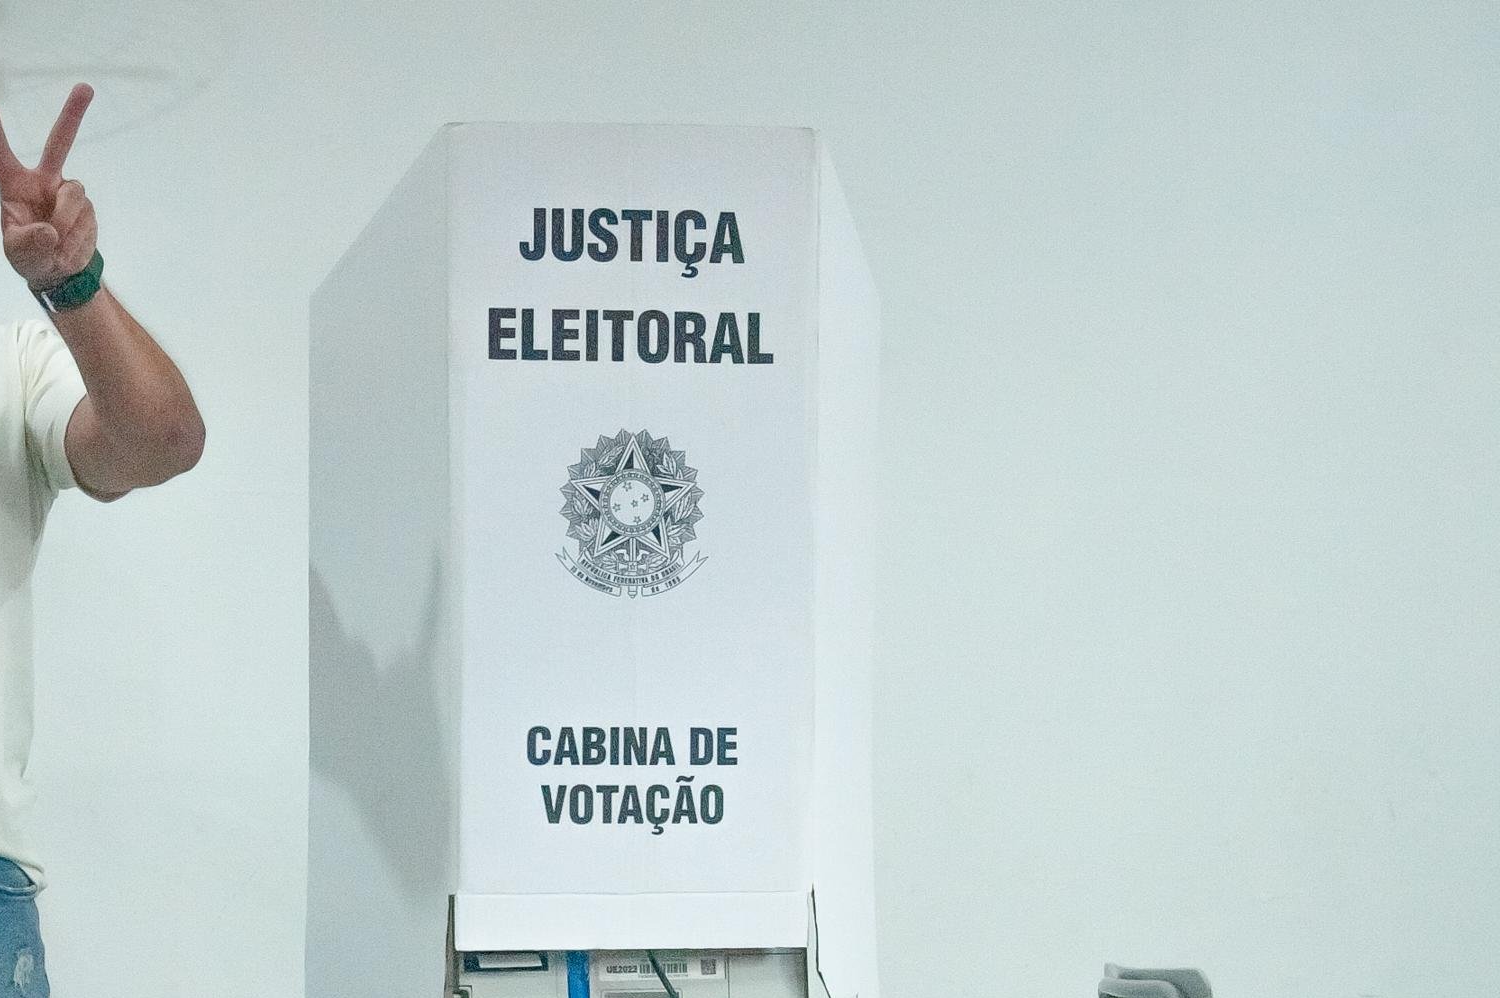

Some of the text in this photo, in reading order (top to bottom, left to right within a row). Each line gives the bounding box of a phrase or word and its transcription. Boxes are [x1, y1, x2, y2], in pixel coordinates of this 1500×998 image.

[518, 207, 746, 278] JUSTIÇA
[487, 307, 775, 365] ELEITORAL
[526, 725, 739, 767] CABINA DE
[540, 775, 725, 836] VOTAÇÃO
